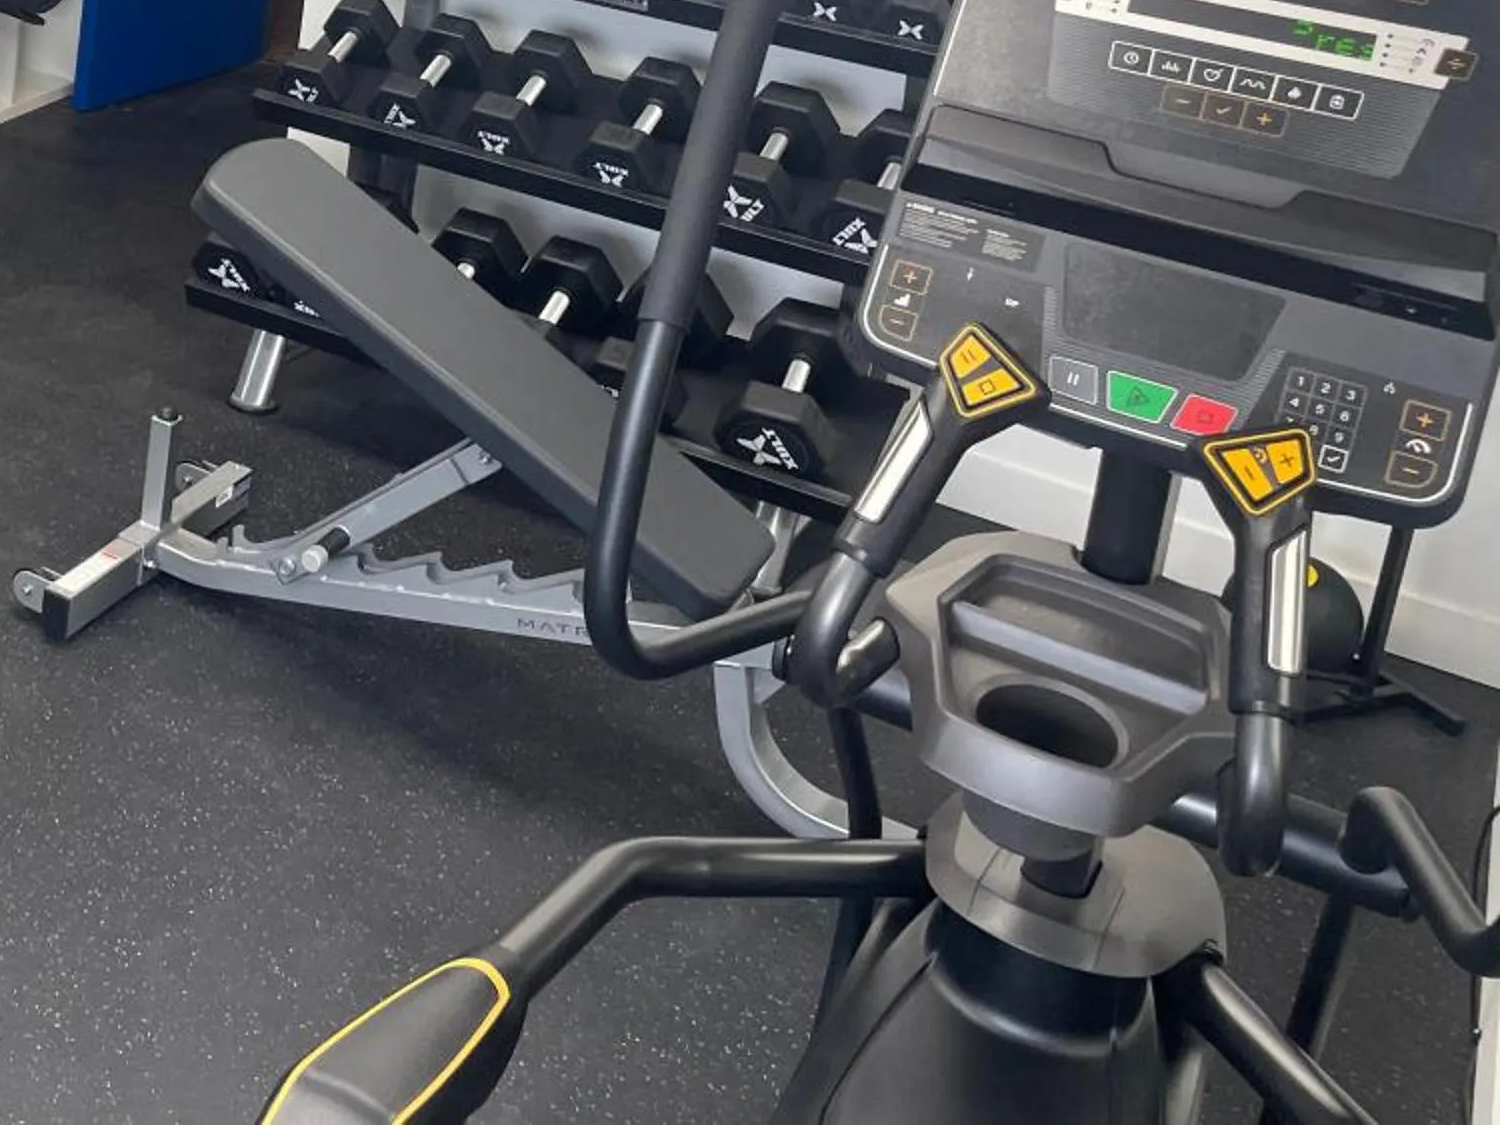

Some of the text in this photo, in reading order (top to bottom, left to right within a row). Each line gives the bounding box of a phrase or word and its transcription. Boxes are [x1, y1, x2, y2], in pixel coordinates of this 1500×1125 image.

[1298, 376, 1356, 401] 1 2 3
[1289, 398, 1349, 422] 4 5 6
[516, 618, 590, 636] MATR
